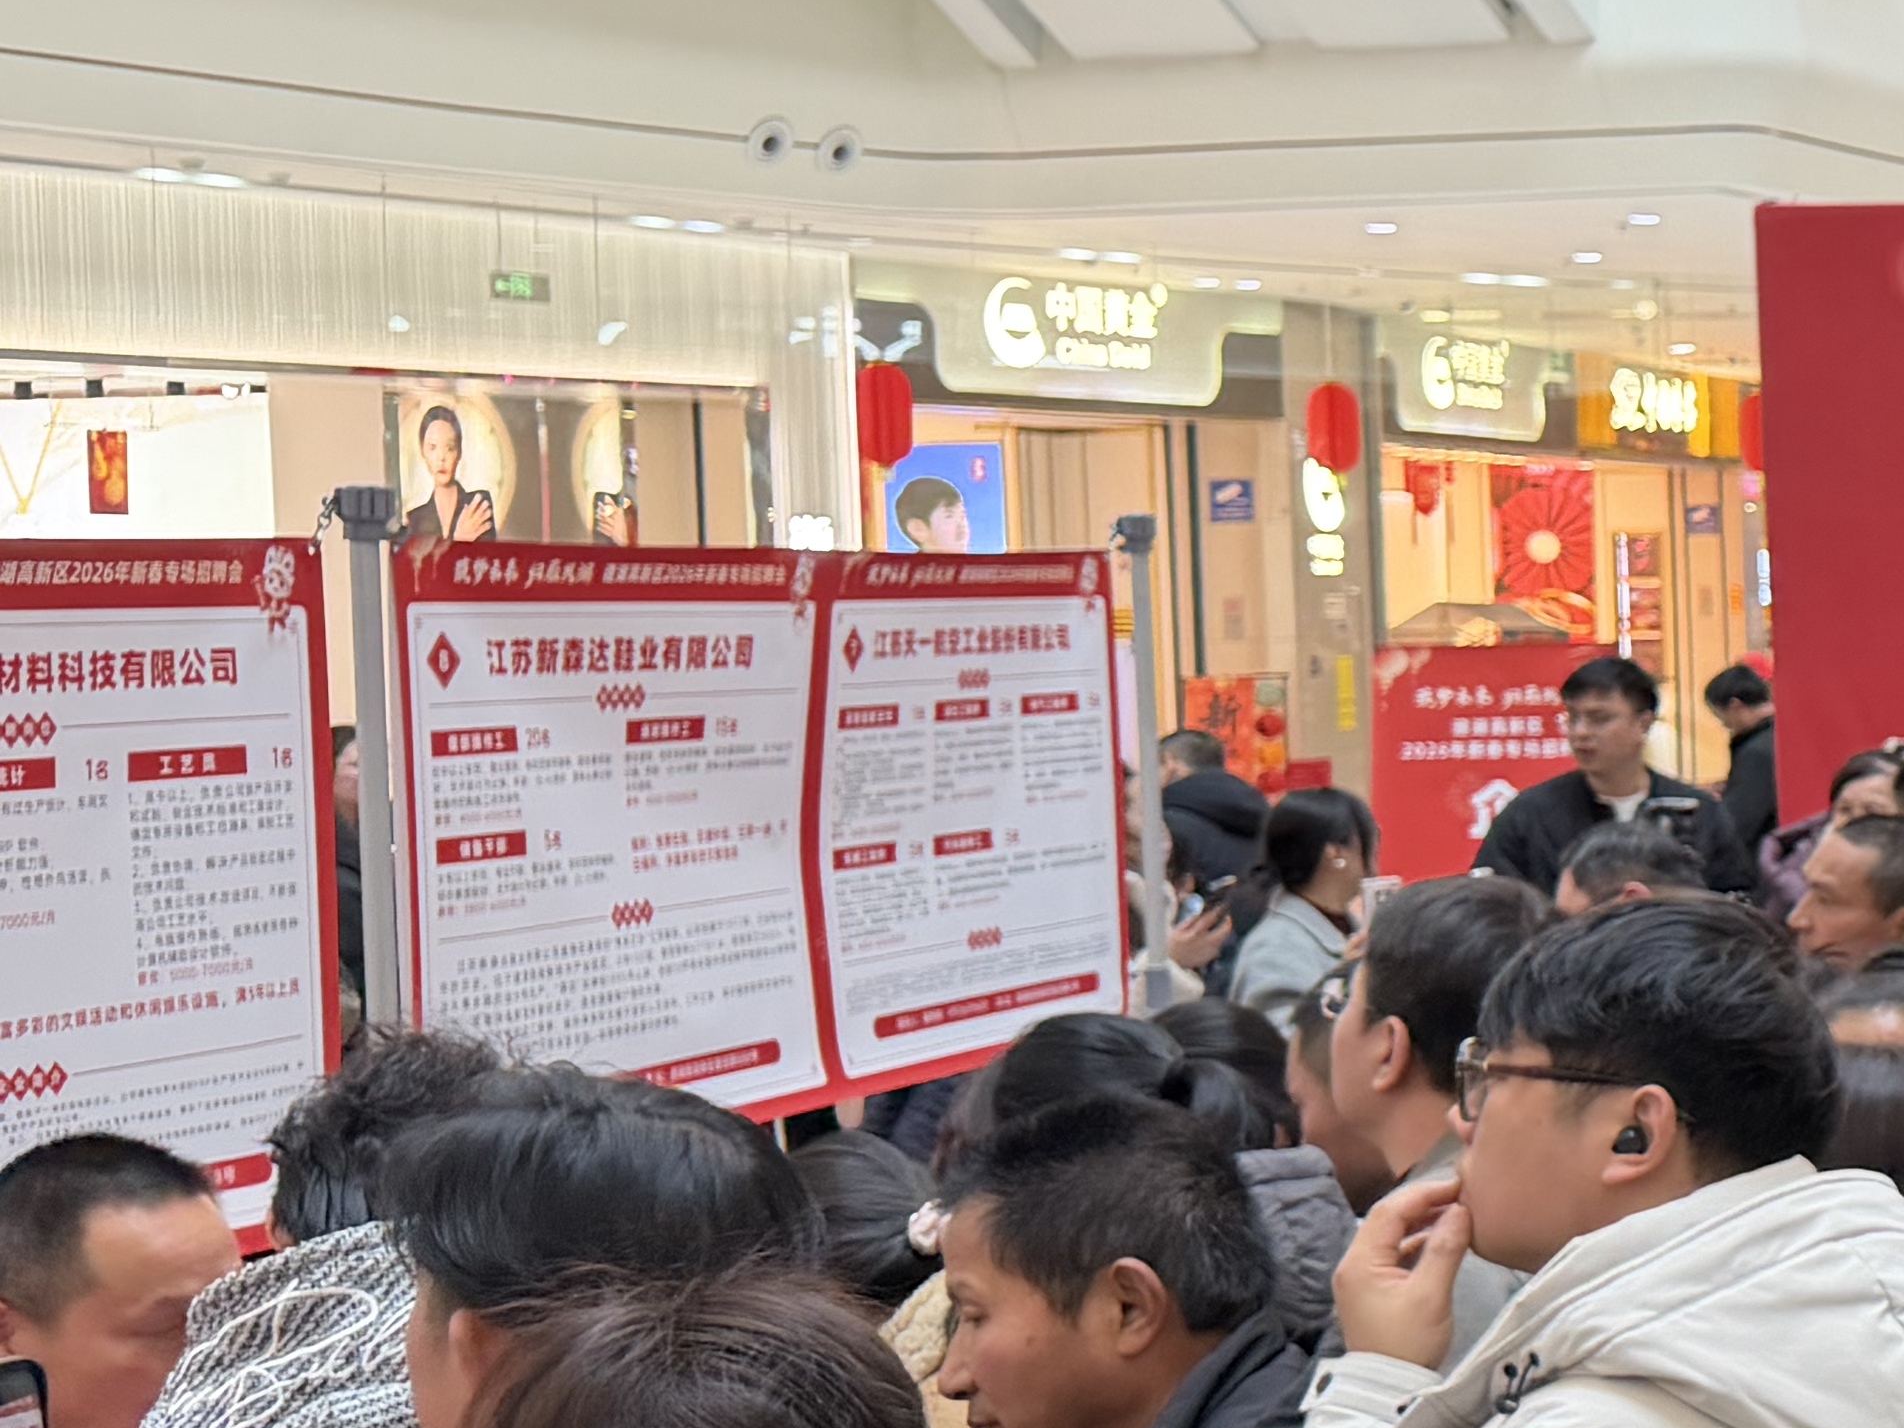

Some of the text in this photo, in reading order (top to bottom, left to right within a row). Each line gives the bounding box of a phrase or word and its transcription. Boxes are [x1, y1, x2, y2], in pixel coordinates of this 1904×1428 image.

[0, 646, 239, 694] 材料科技有限公司
